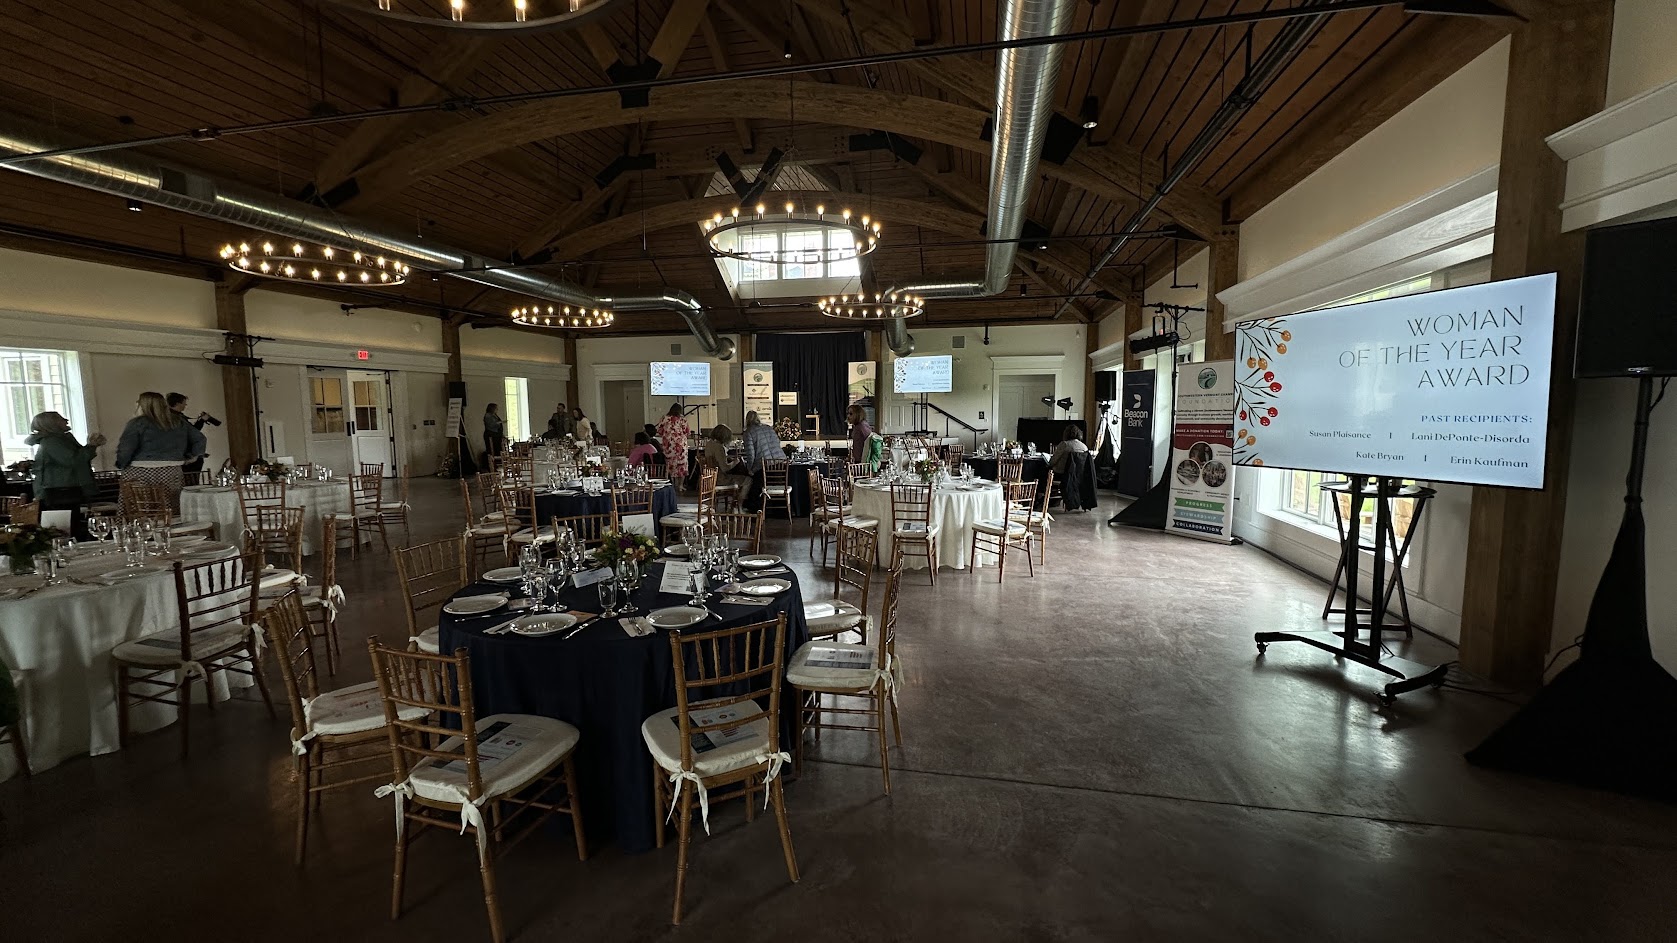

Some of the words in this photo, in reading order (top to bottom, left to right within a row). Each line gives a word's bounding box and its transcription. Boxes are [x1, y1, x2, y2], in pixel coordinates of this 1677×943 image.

[1407, 305, 1523, 337] WOMAN
[1339, 349, 1370, 368] OF
[1380, 343, 1430, 365] THE
[1441, 335, 1522, 360] YEAR
[1418, 364, 1530, 389] AWARD
[1124, 409, 1149, 419] Beacon
[1421, 415, 1450, 423] PAST
[1454, 415, 1533, 423] RECIPIENTS:
[1128, 418, 1143, 427] Bank
[1309, 430, 1332, 438] Susan
[1333, 430, 1372, 439] Plaisance
[1411, 432, 1433, 441] Lani
[1434, 433, 1530, 444] DePonte-Disorda
[1356, 451, 1376, 459] Kate
[1377, 452, 1404, 461] Bryan
[1450, 456, 1472, 465] Erin
[1474, 457, 1529, 468] Kaufman
[1180, 511, 1217, 520] STEWARDSHIP
[1176, 521, 1220, 532] COLLABORATION
